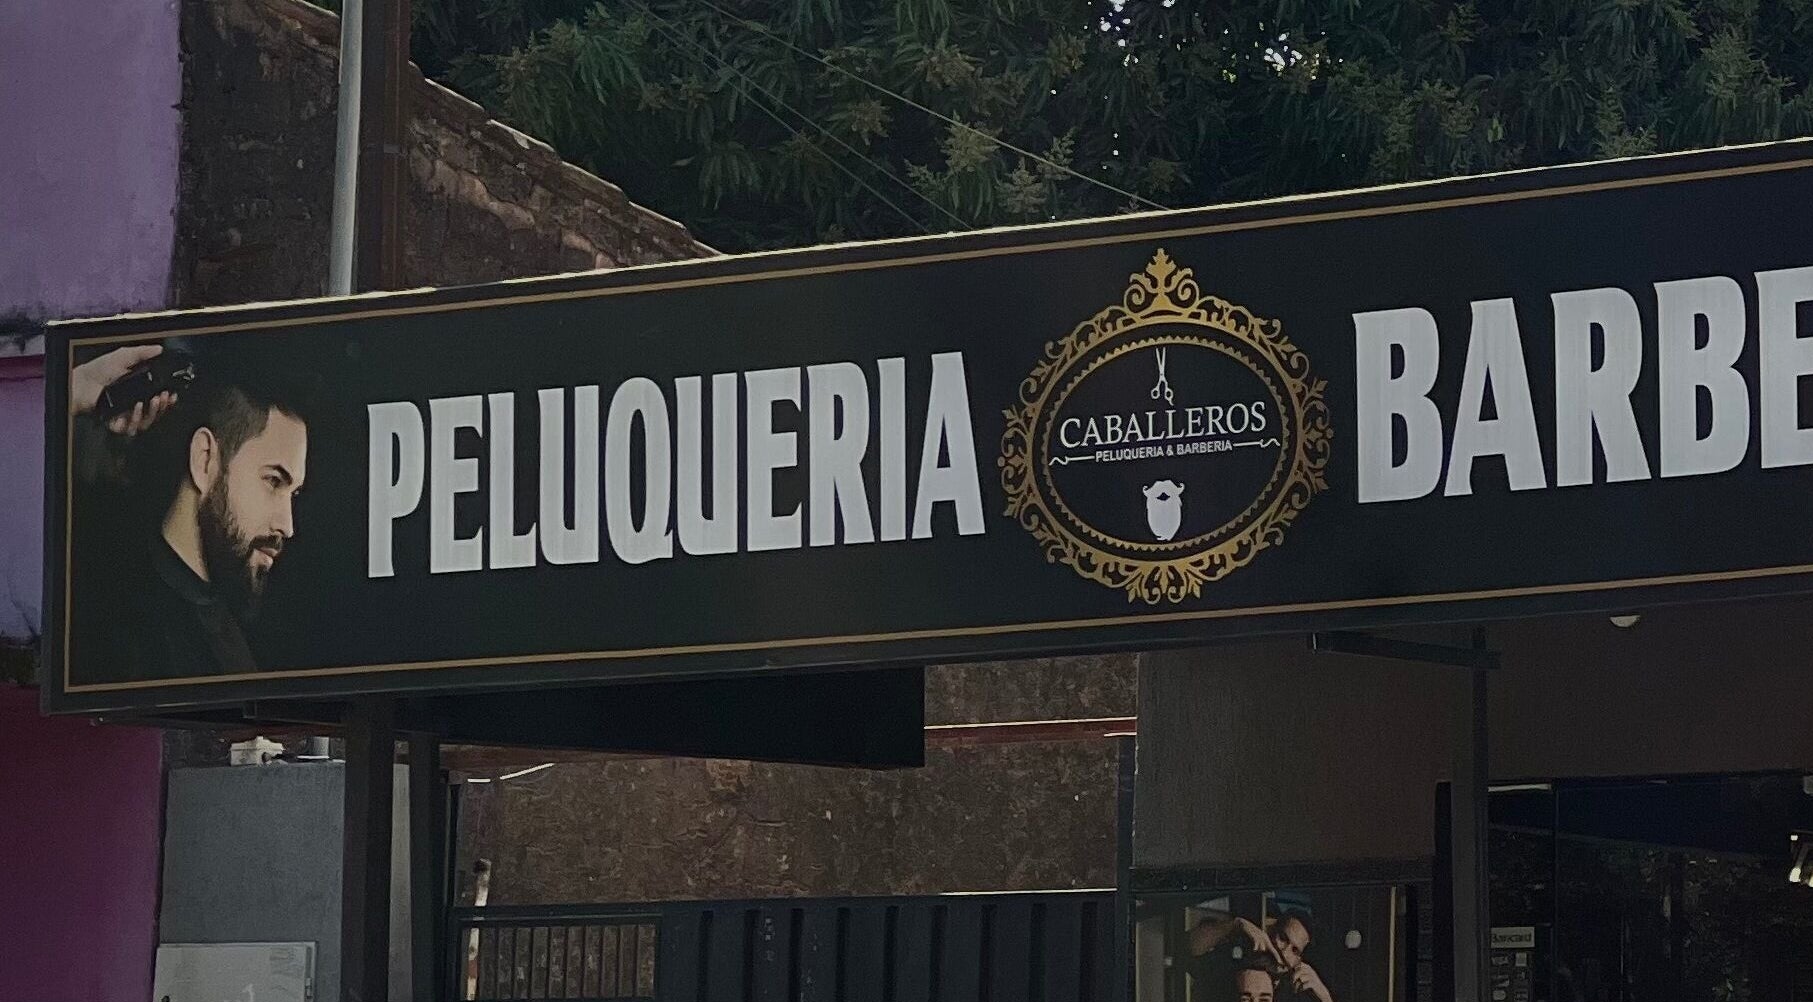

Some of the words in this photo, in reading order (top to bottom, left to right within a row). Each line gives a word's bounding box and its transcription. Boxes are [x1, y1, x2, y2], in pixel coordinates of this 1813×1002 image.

[1059, 401, 1267, 449] CABALLEROS
[367, 351, 986, 578] PELUQUERIA
[1095, 446, 1165, 463] PELUQUERIA
[1166, 446, 1175, 457] &
[1176, 439, 1233, 456] BARBERIA
